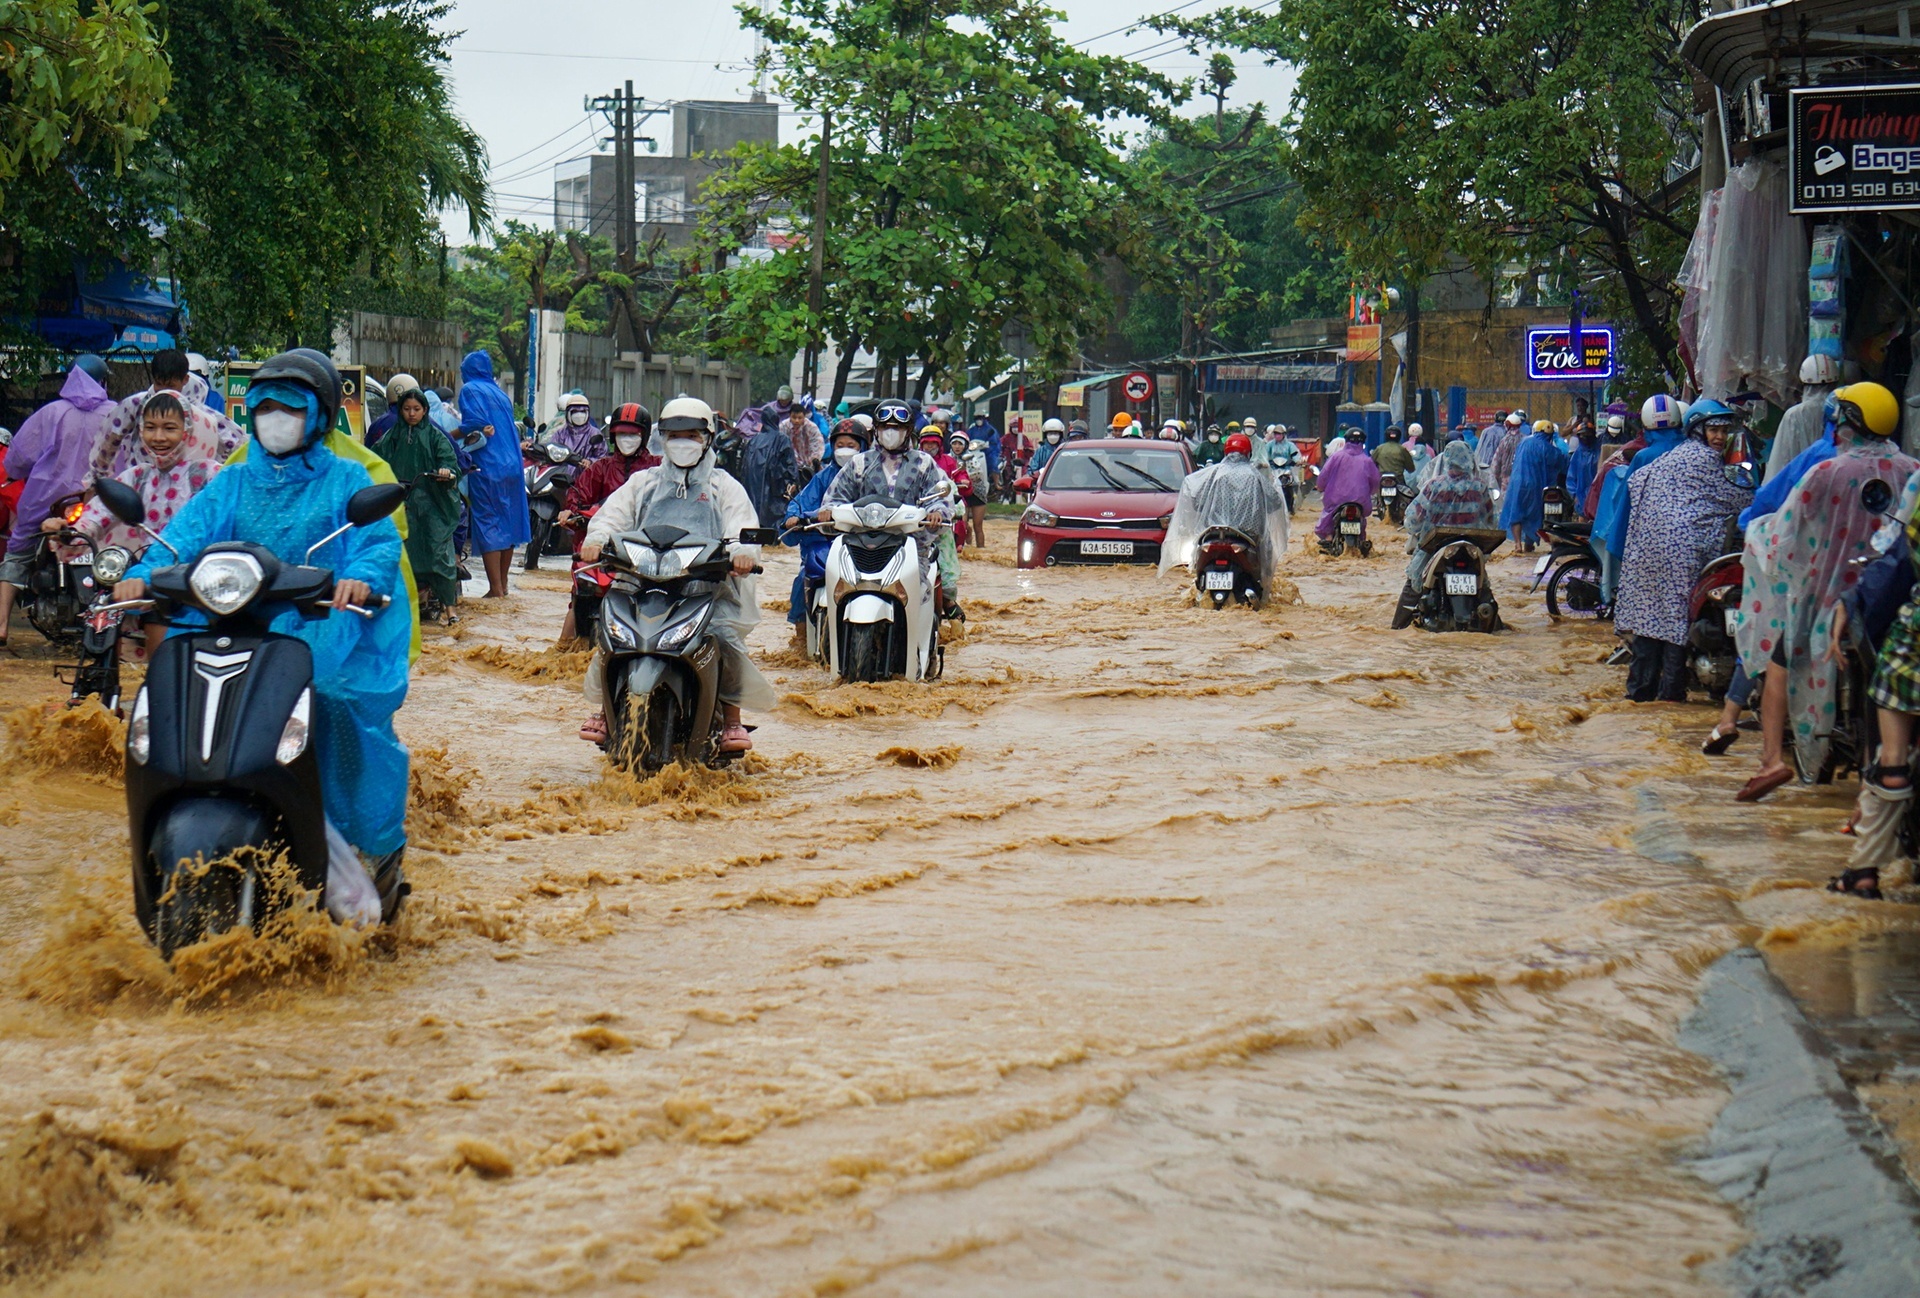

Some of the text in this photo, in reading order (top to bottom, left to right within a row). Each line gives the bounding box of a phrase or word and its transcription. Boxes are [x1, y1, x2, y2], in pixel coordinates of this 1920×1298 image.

[1803, 185, 1845, 199] 0773
[1851, 183, 1886, 197] 508
[1536, 347, 1581, 369] TÓC
[1082, 543, 1132, 555] 43A-515.95
[1208, 580, 1232, 589] 167.48
[1449, 585, 1475, 594] 154.36
